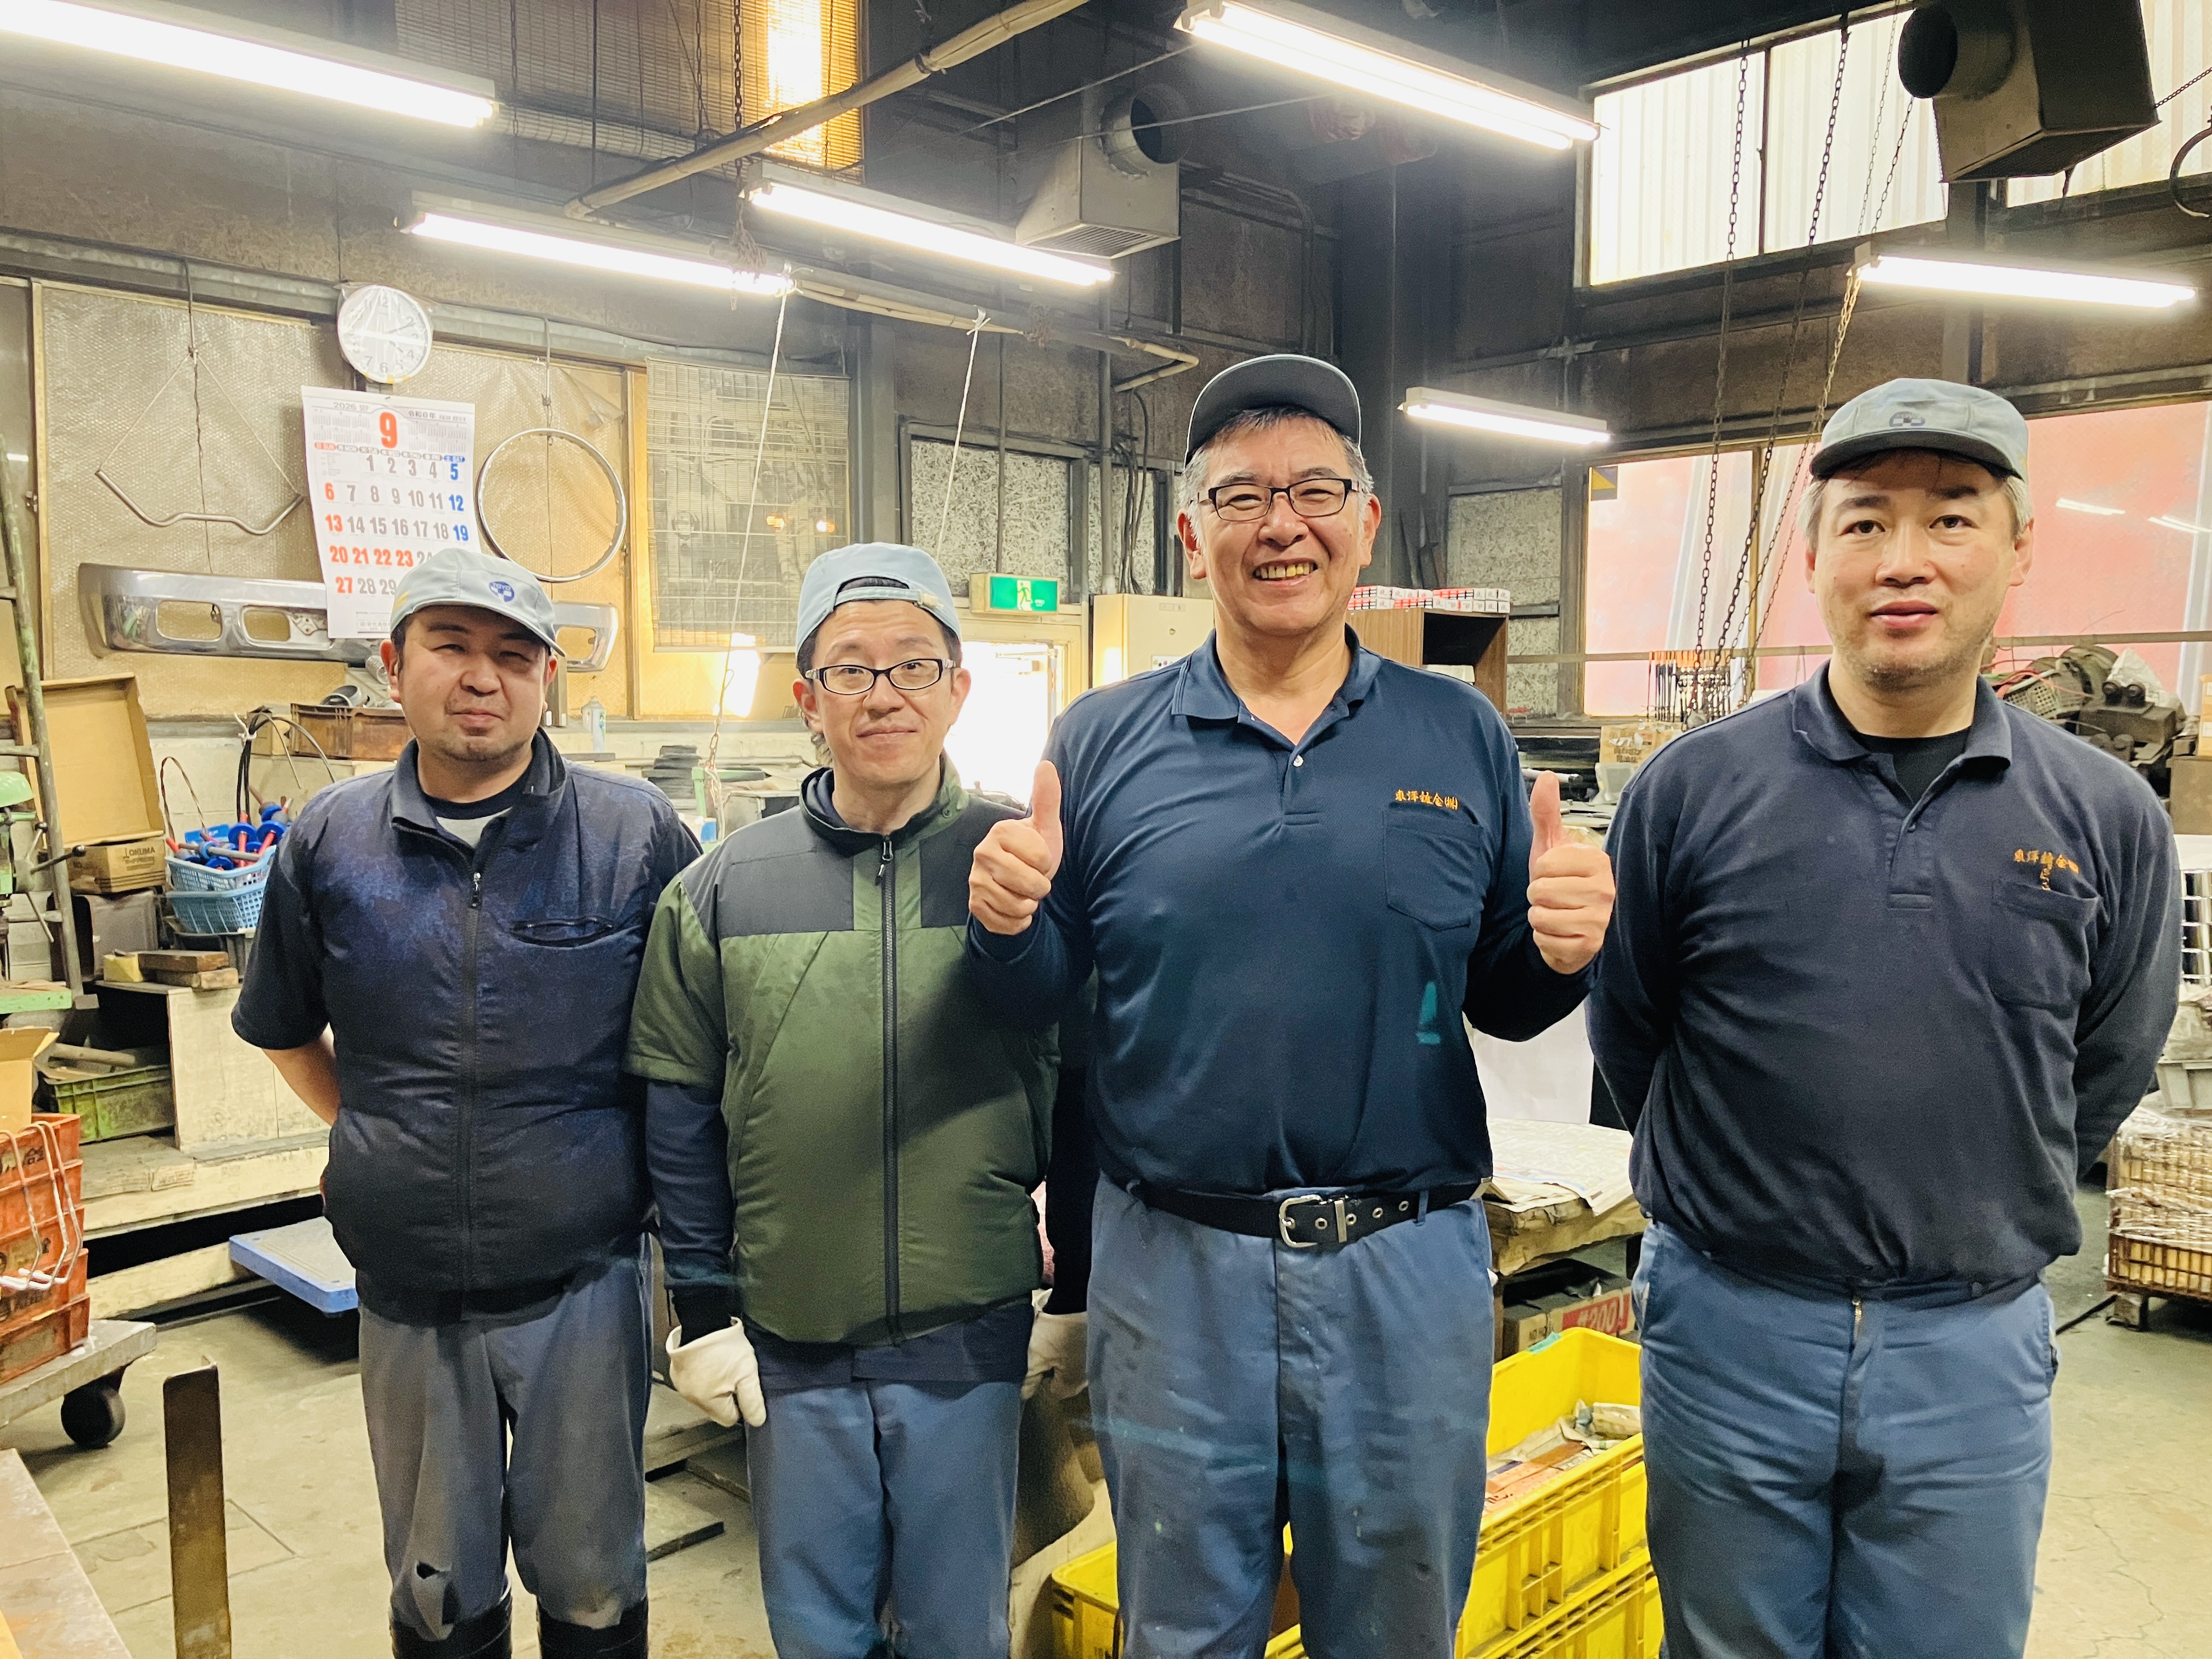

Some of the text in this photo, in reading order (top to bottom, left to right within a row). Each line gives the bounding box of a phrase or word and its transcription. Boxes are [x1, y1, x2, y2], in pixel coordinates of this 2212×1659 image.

[364, 356, 373, 366] 7
[407, 349, 414, 360] 4
[380, 362, 388, 374] 6
[333, 402, 357, 410] 2026
[379, 412, 398, 448] 9
[366, 455, 459, 481] 1 2 3 4 5
[325, 483, 464, 511] 6 7 8 9 10 11 12
[325, 514, 469, 541] 13 14 15 16 17 18 19
[330, 545, 348, 563] 20
[352, 548, 369, 565] 21
[374, 549, 392, 566] 22
[396, 549, 413, 567] 23
[335, 577, 397, 595] 27 28 29
[492, 582, 511, 591] TOYO
